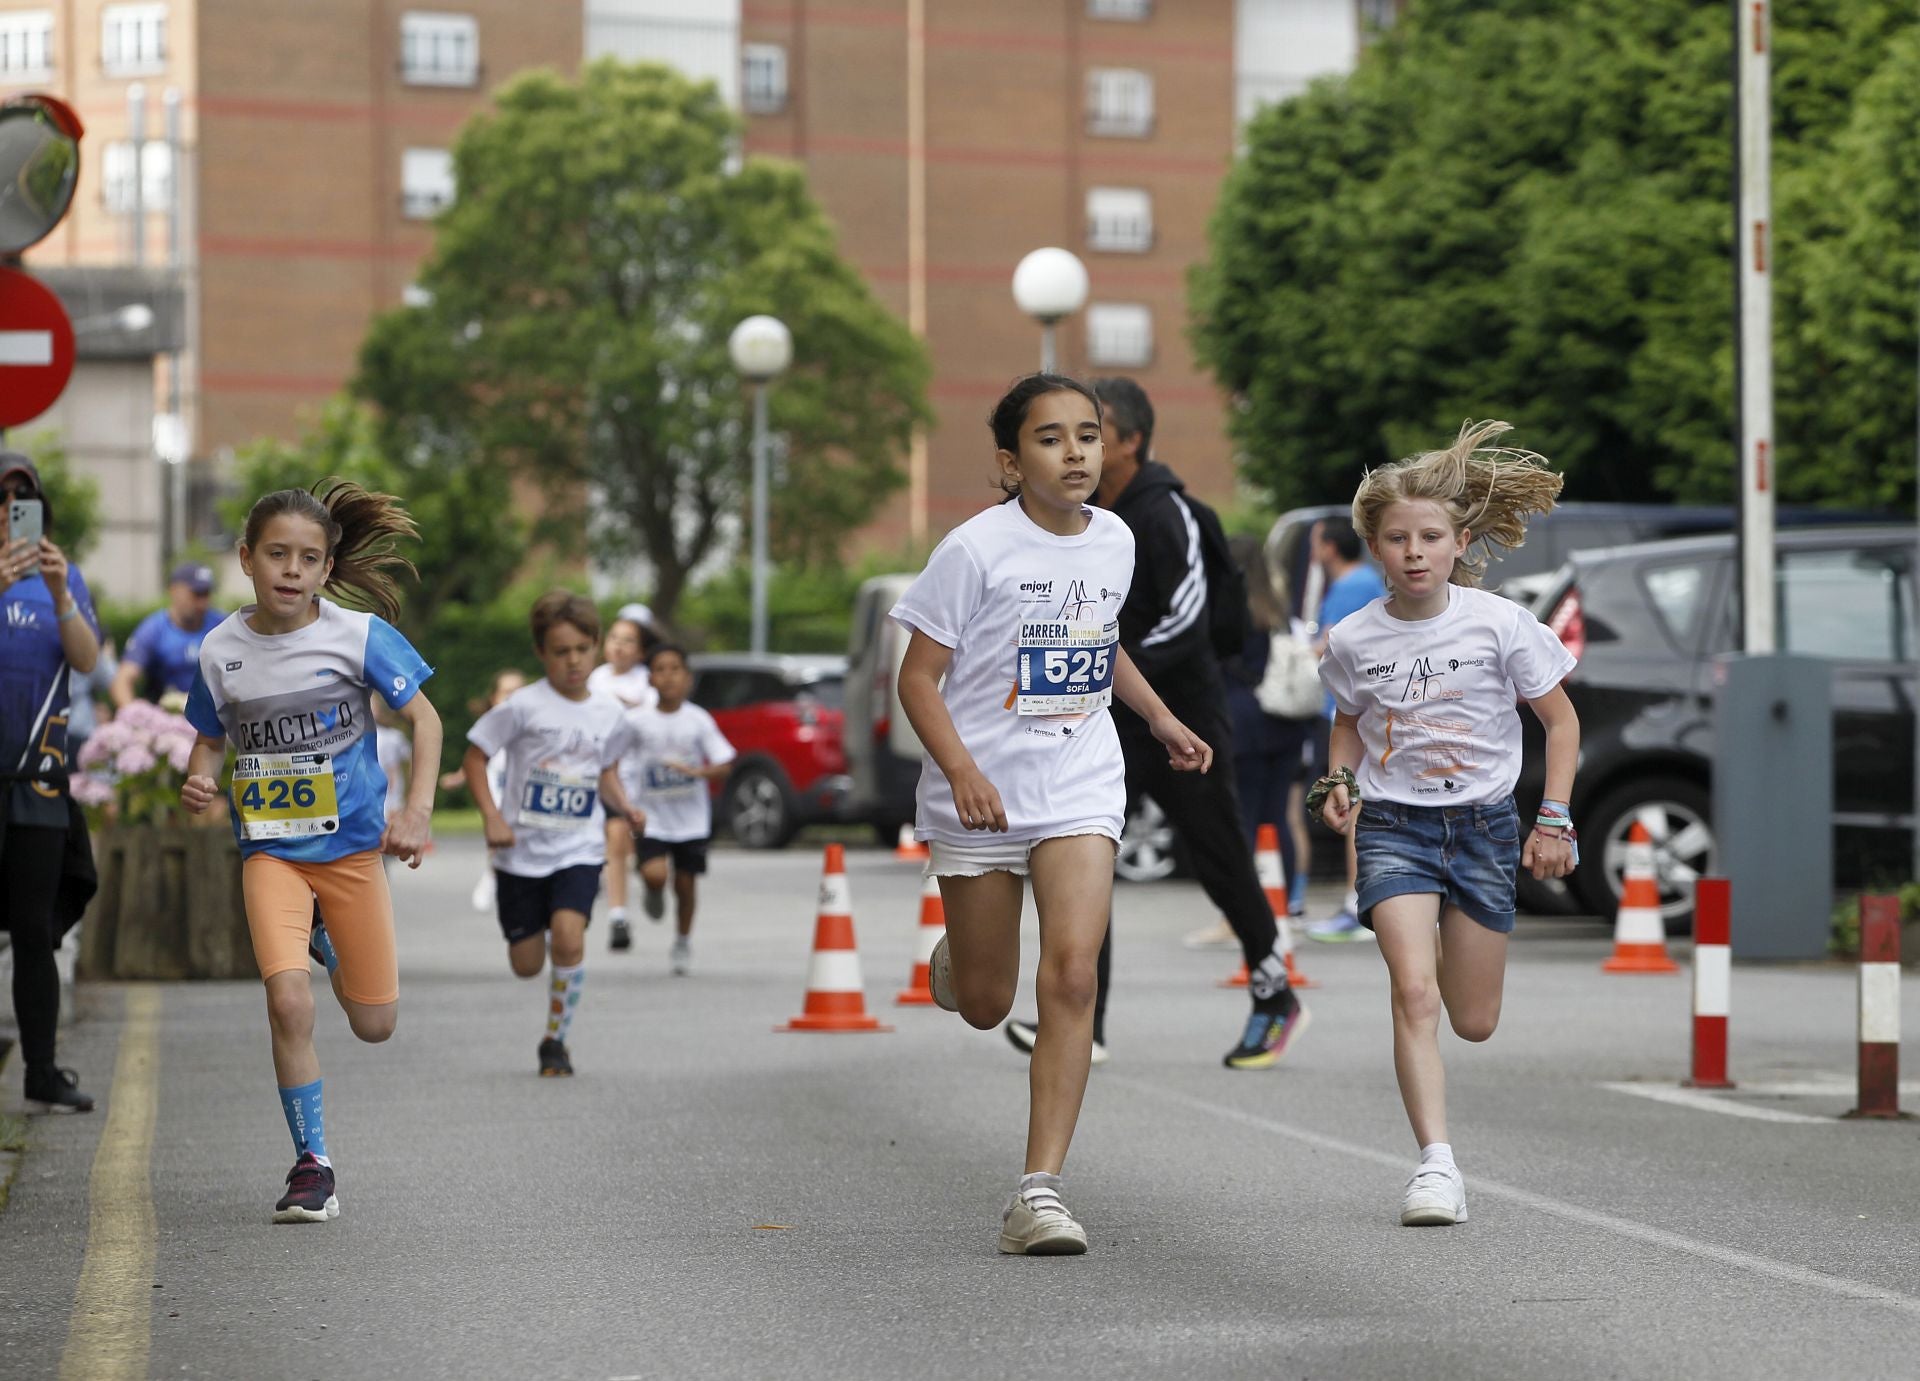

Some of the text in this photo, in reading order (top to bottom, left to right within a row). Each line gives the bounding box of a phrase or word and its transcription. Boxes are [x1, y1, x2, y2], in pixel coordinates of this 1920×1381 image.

[1020, 580, 1053, 594] enjoy!
[1022, 624, 1069, 638] CARRERA
[1029, 638, 1061, 647] ANIVERSARIO
[1062, 638, 1069, 647] DE
[1078, 638, 1100, 646] FACULTAD
[1044, 648, 1110, 684] 525
[1367, 662, 1396, 676] enjoy!
[1066, 683, 1090, 693] SOFÍA
[323, 729, 354, 747] AUTISTA
[269, 768, 292, 776] FACULTAD
[292, 767, 308, 775] PADRE
[241, 779, 316, 811] 426
